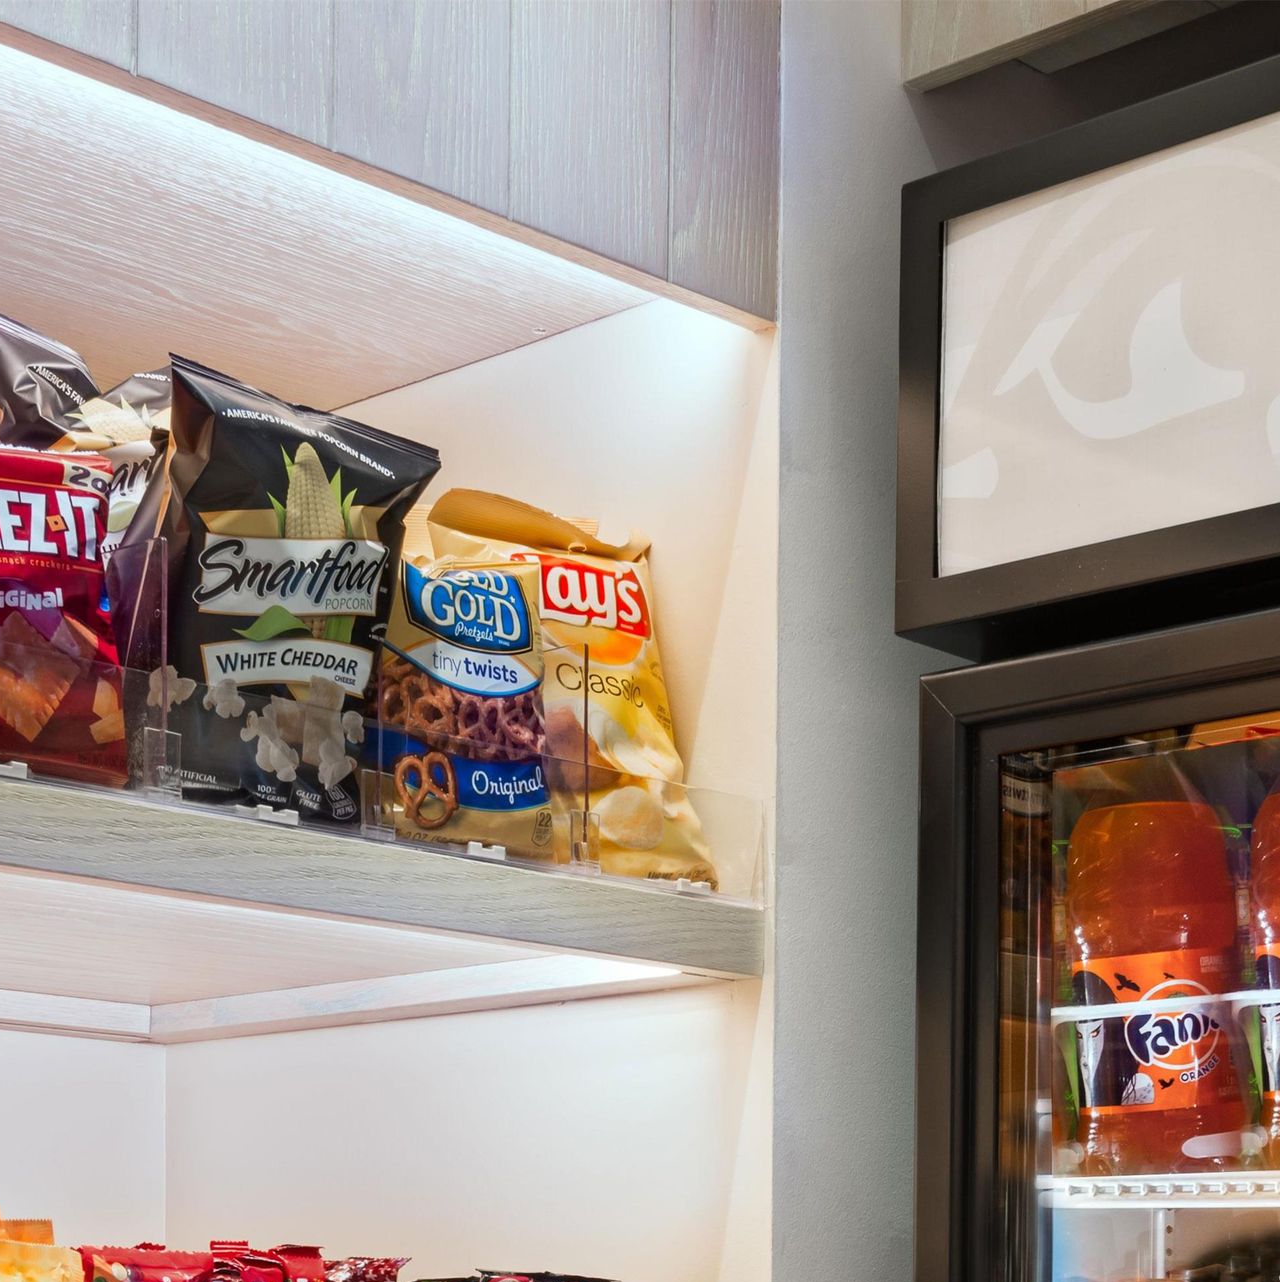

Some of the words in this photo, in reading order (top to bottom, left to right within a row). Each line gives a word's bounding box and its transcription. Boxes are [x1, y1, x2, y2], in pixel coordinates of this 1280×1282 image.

[226, 407, 275, 424] AMERICA'S
[317, 430, 359, 460] POPCORN
[358, 453, 394, 478] BRAND
[194, 537, 388, 605] Smartfood
[324, 596, 374, 612] POPCORN
[421, 584, 521, 642] GOLD
[216, 648, 276, 675] WHITE
[280, 648, 358, 675] CHEDDAR
[432, 650, 462, 674] tiny
[464, 656, 518, 684] twists
[556, 663, 645, 708] Classic
[472, 770, 545, 805] Original
[1179, 1055, 1221, 1085] ORANGE
